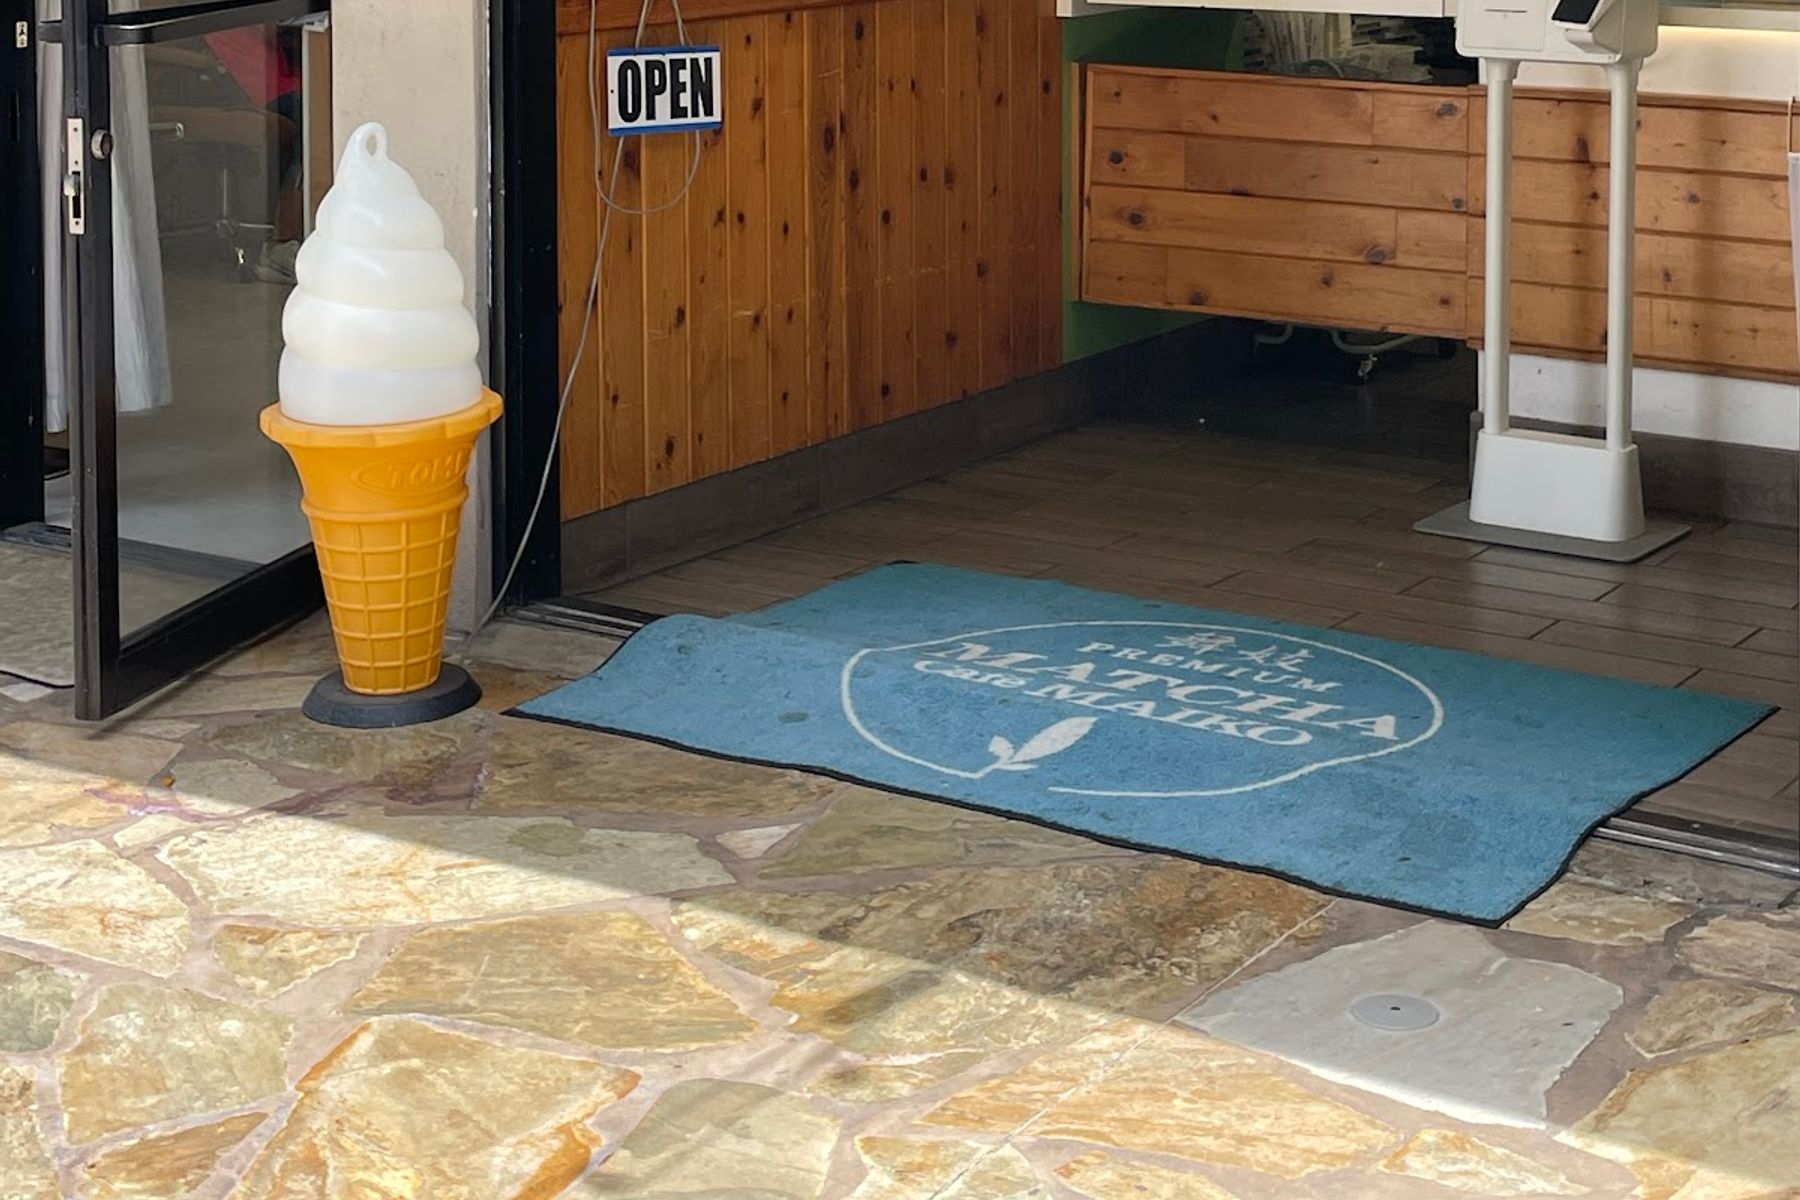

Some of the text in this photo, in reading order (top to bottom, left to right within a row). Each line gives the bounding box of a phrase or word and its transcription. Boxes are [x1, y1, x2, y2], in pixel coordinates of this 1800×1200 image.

[617, 57, 714, 123] OPEN
[926, 641, 1400, 740] MATCHA
[1078, 641, 1343, 693] PREMIUM
[1026, 682, 1313, 746] MAIKO
